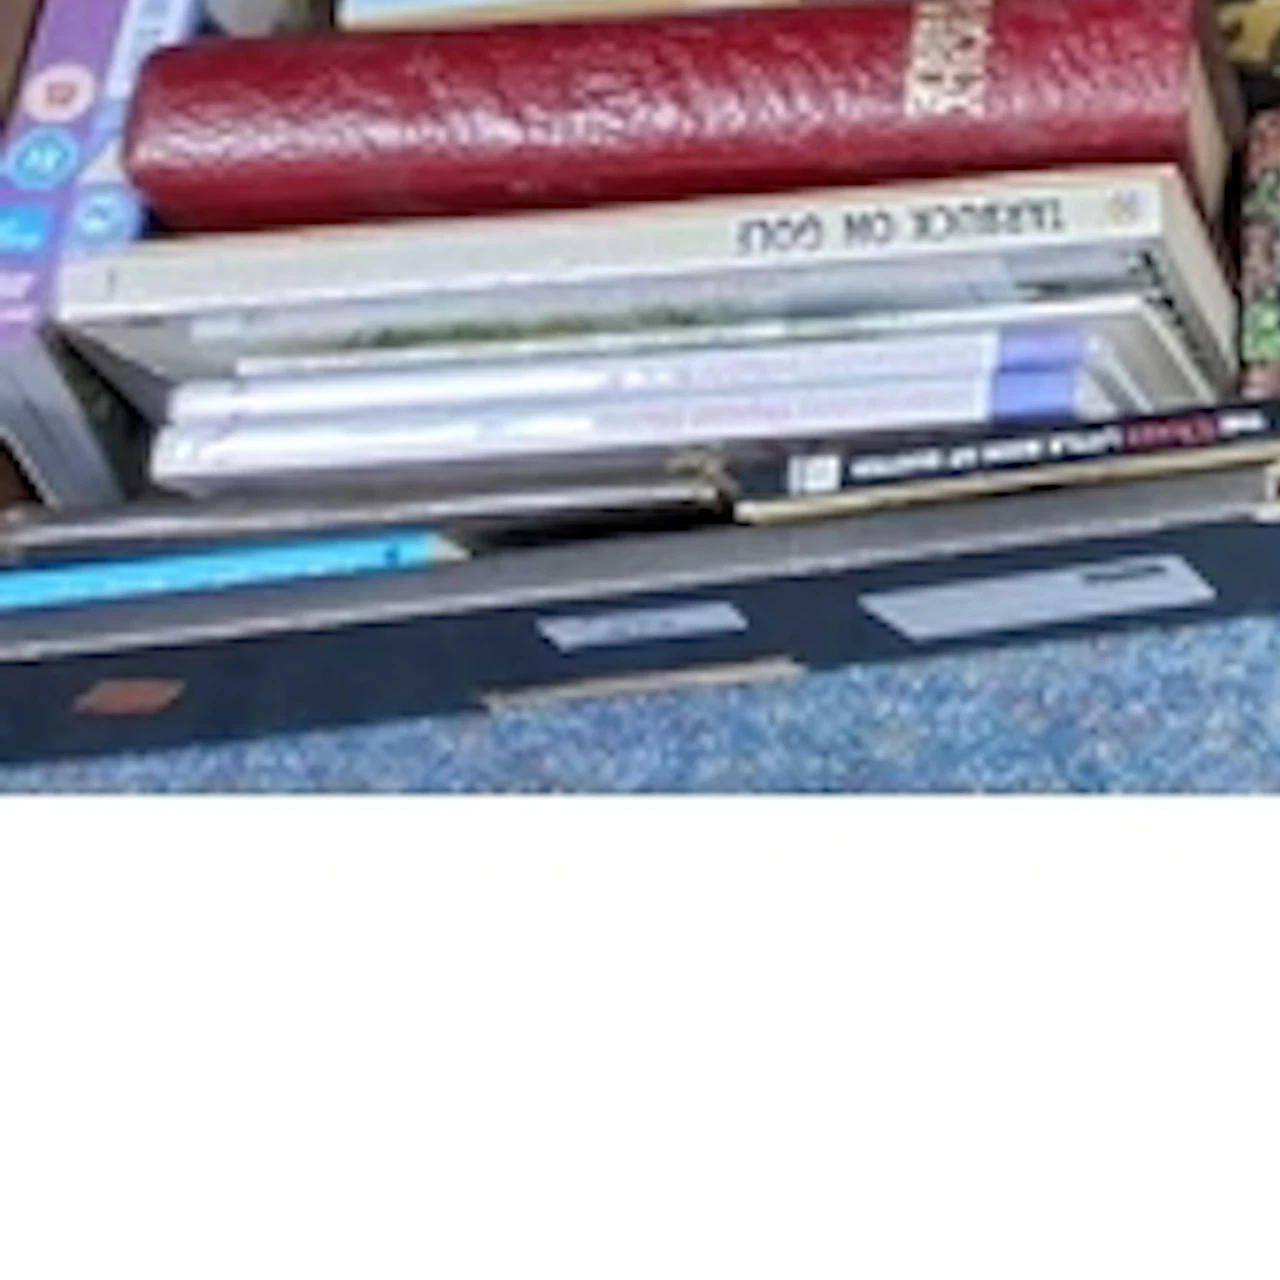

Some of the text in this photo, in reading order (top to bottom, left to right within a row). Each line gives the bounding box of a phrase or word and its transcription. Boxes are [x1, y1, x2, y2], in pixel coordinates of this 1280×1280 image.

[730, 191, 1064, 260] TARBUCK ON GOLF
